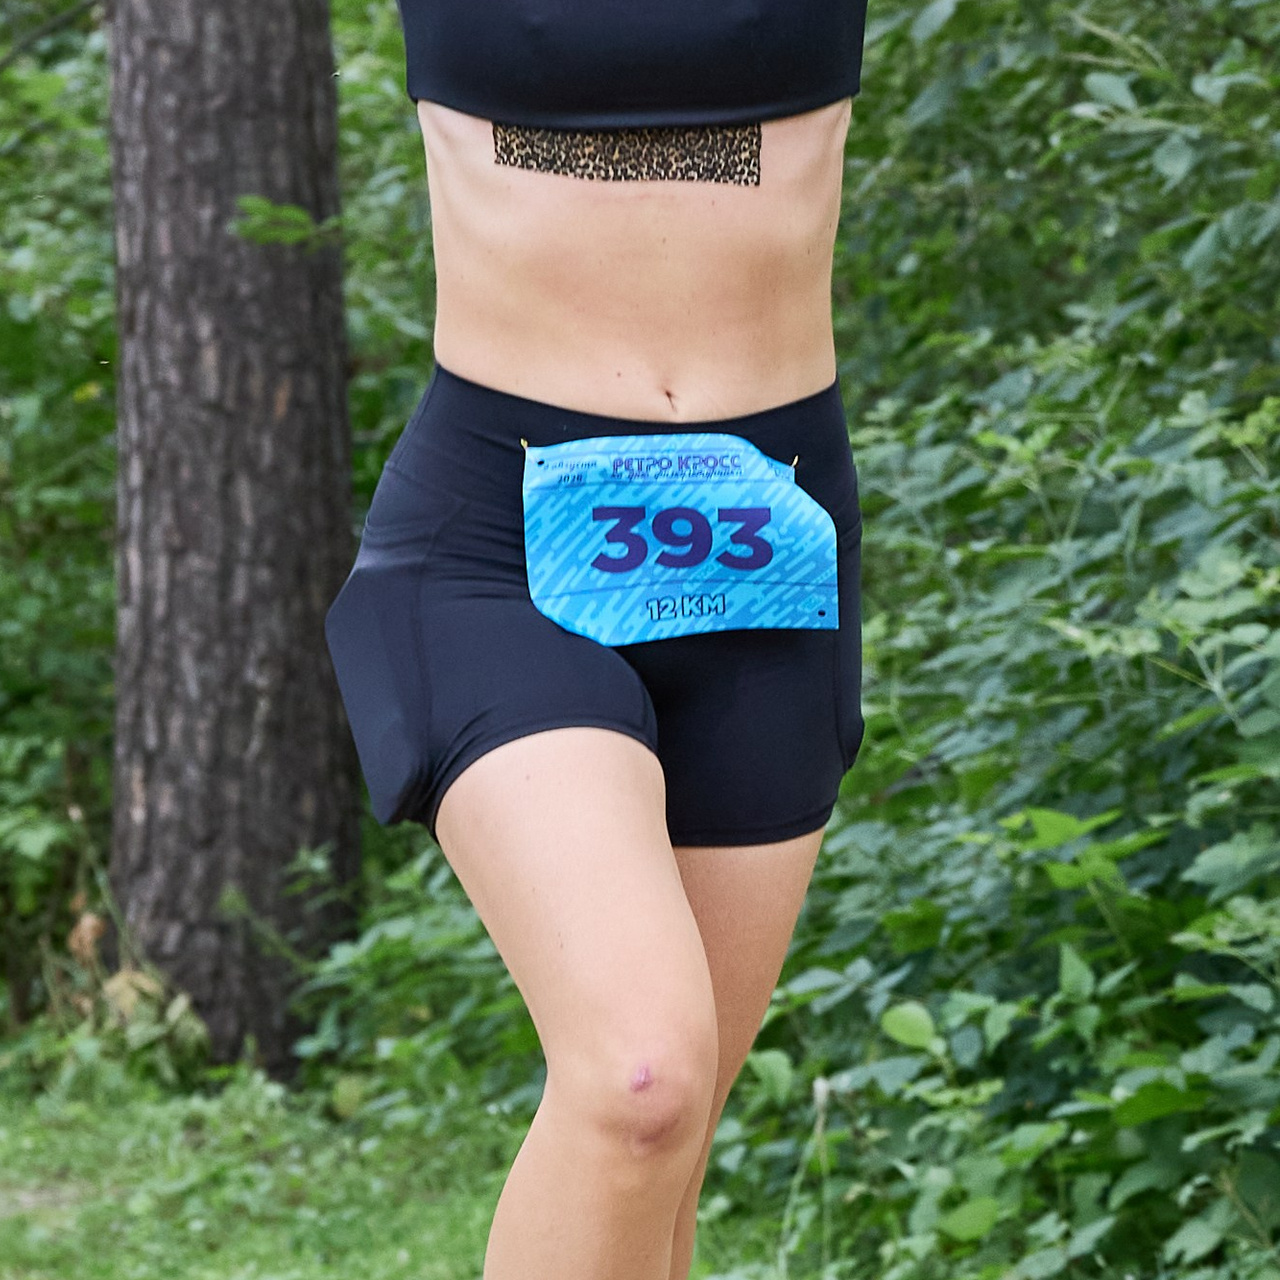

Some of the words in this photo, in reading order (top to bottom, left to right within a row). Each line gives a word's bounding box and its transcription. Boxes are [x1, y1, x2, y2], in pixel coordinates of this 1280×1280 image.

[612, 457, 673, 472] РЕТРО
[677, 454, 741, 471] КРОСС
[590, 505, 774, 573] 393
[646, 595, 677, 622] 12
